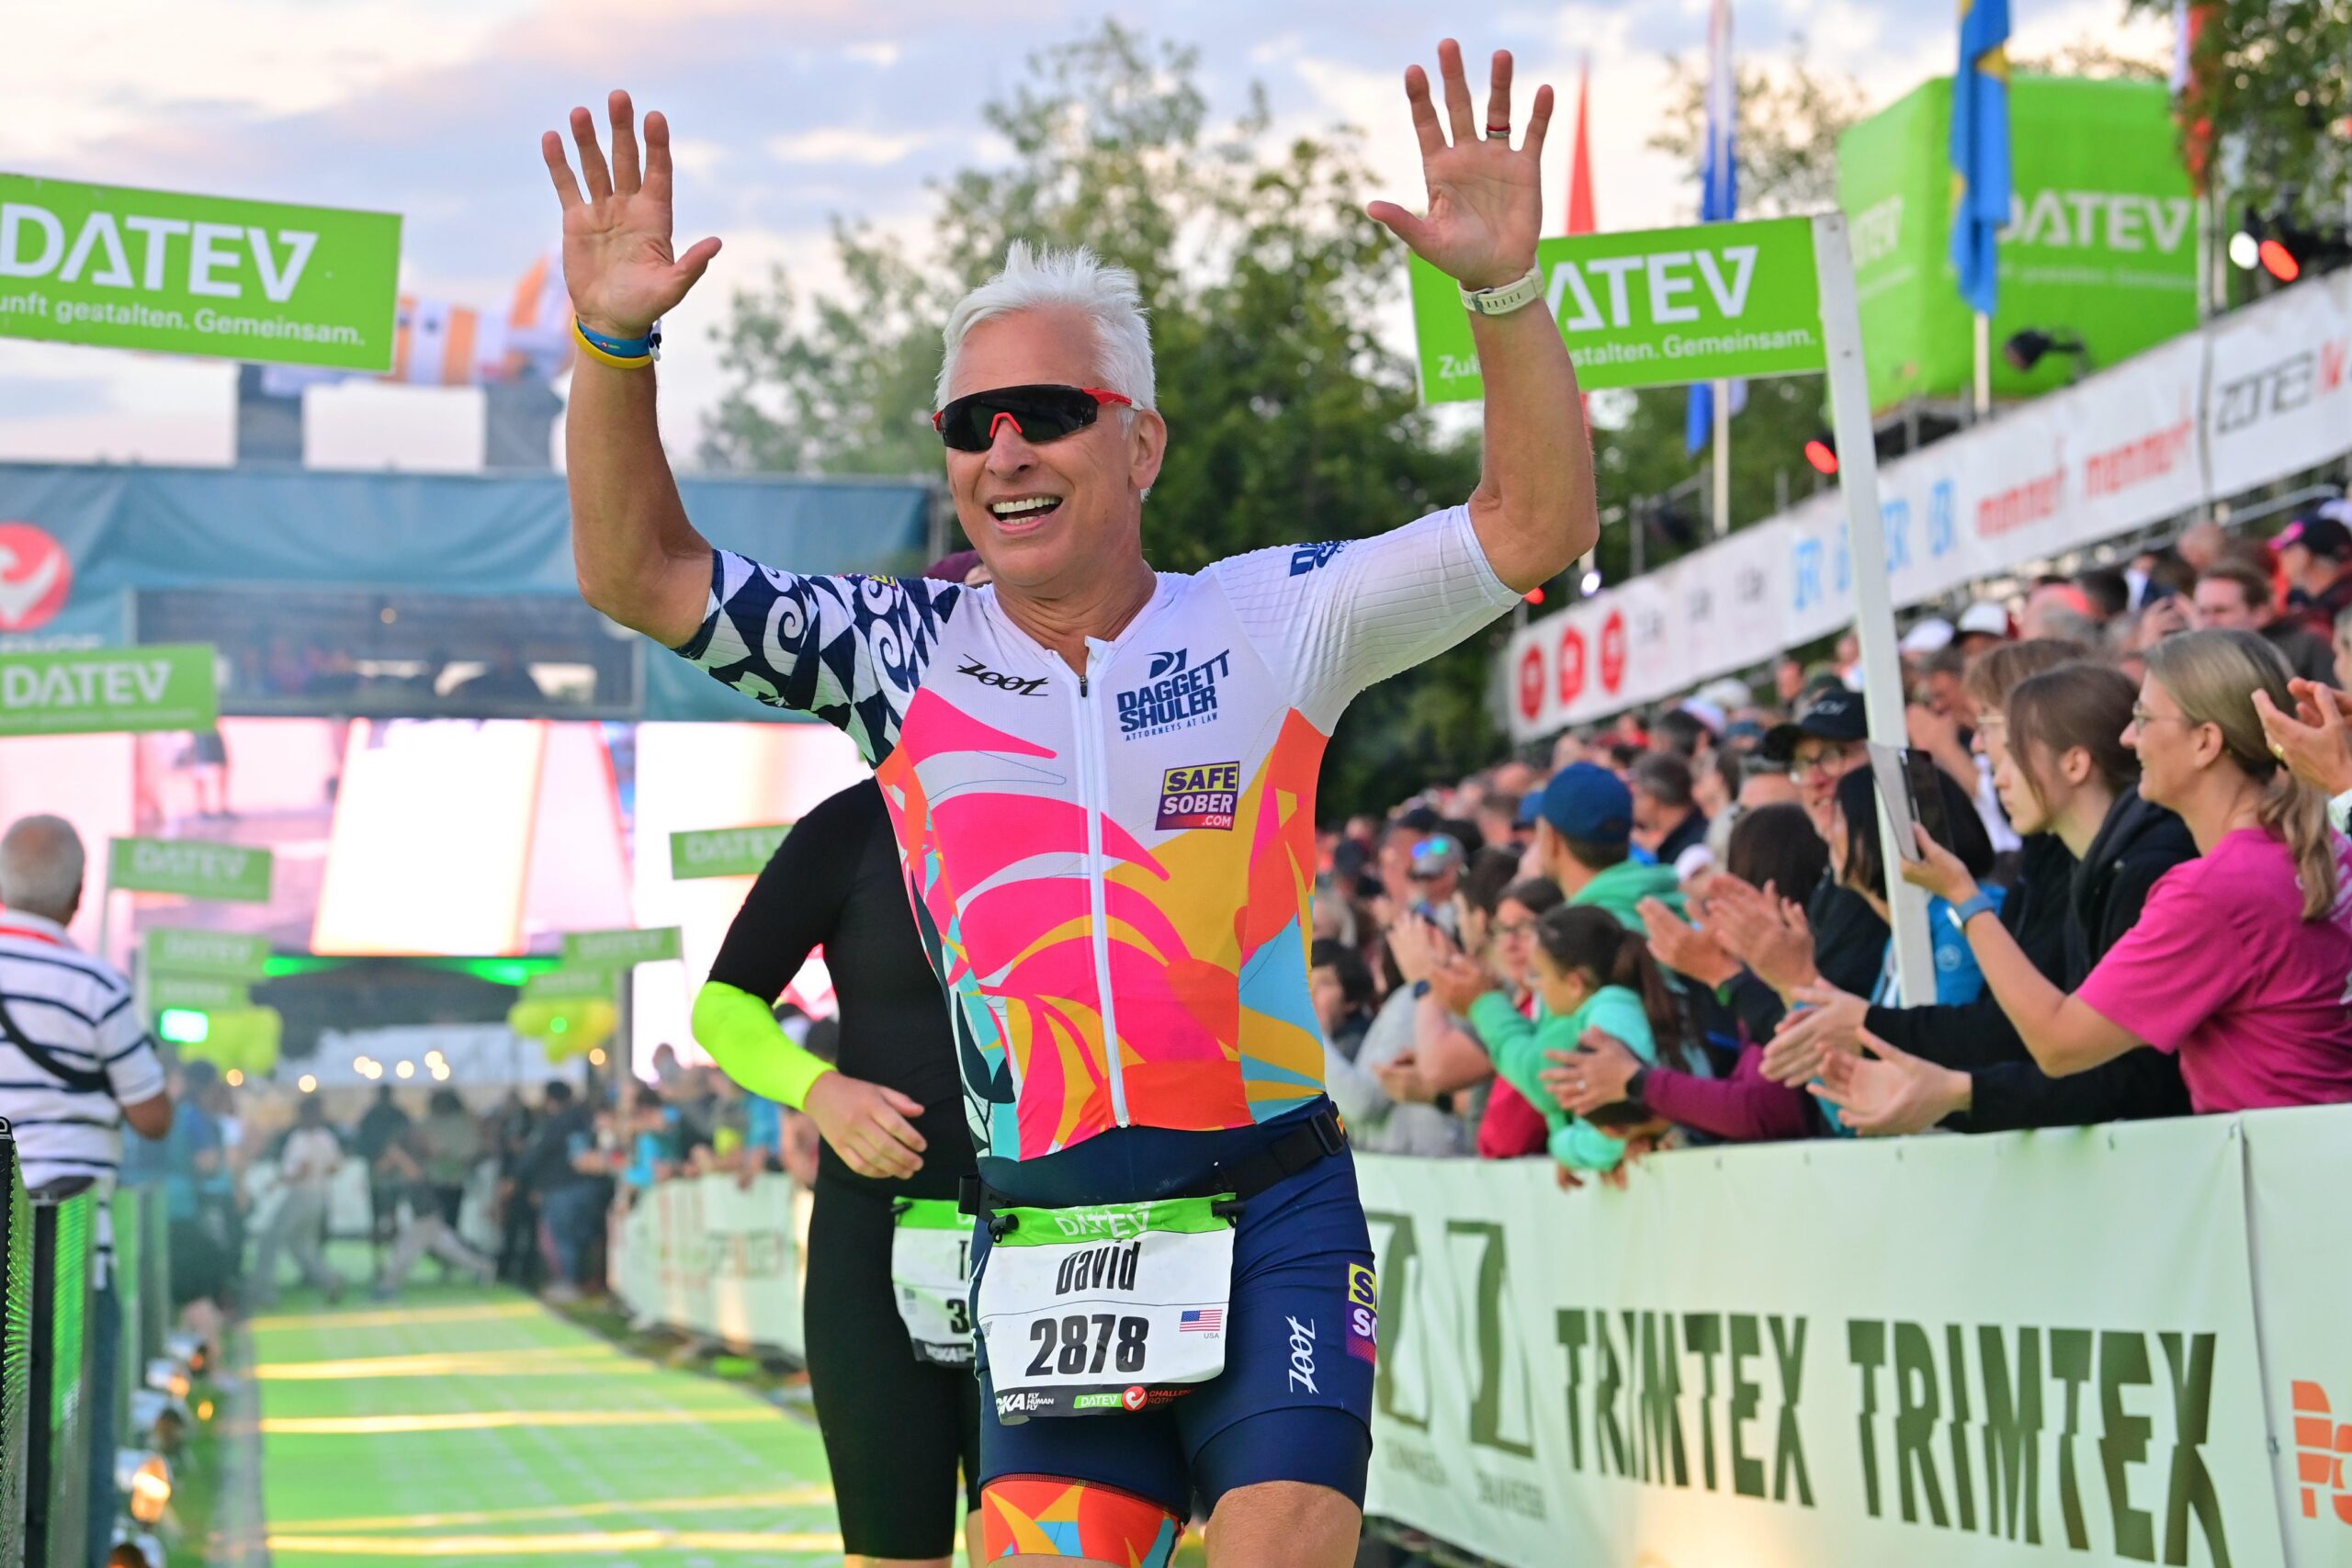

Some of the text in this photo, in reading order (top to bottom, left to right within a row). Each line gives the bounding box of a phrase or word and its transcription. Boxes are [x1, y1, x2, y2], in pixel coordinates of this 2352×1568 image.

[0, 202, 319, 303] DATEV
[1545, 244, 1760, 332] ATEV
[194, 308, 366, 346] Gemeinsam.
[1663, 327, 1817, 359] Gemeinsam.
[3, 660, 172, 708] DATEV
[1117, 649, 1229, 713] DAGGETT
[1120, 685, 1217, 733] SHULER
[1125, 713, 1217, 741] ATTORNEYS AT LAW
[1167, 766, 1237, 792] SAFE
[1162, 794, 1233, 815] SOBER
[1202, 815, 1231, 827] .COM
[1055, 1211, 1149, 1238] DATEV
[1056, 1238, 1141, 1295] David
[1025, 1314, 1149, 1377] 2878
[1080, 1394, 1118, 1406] DATEV
[1555, 1309, 2232, 1568] TRIMTEX TRIMTEX
